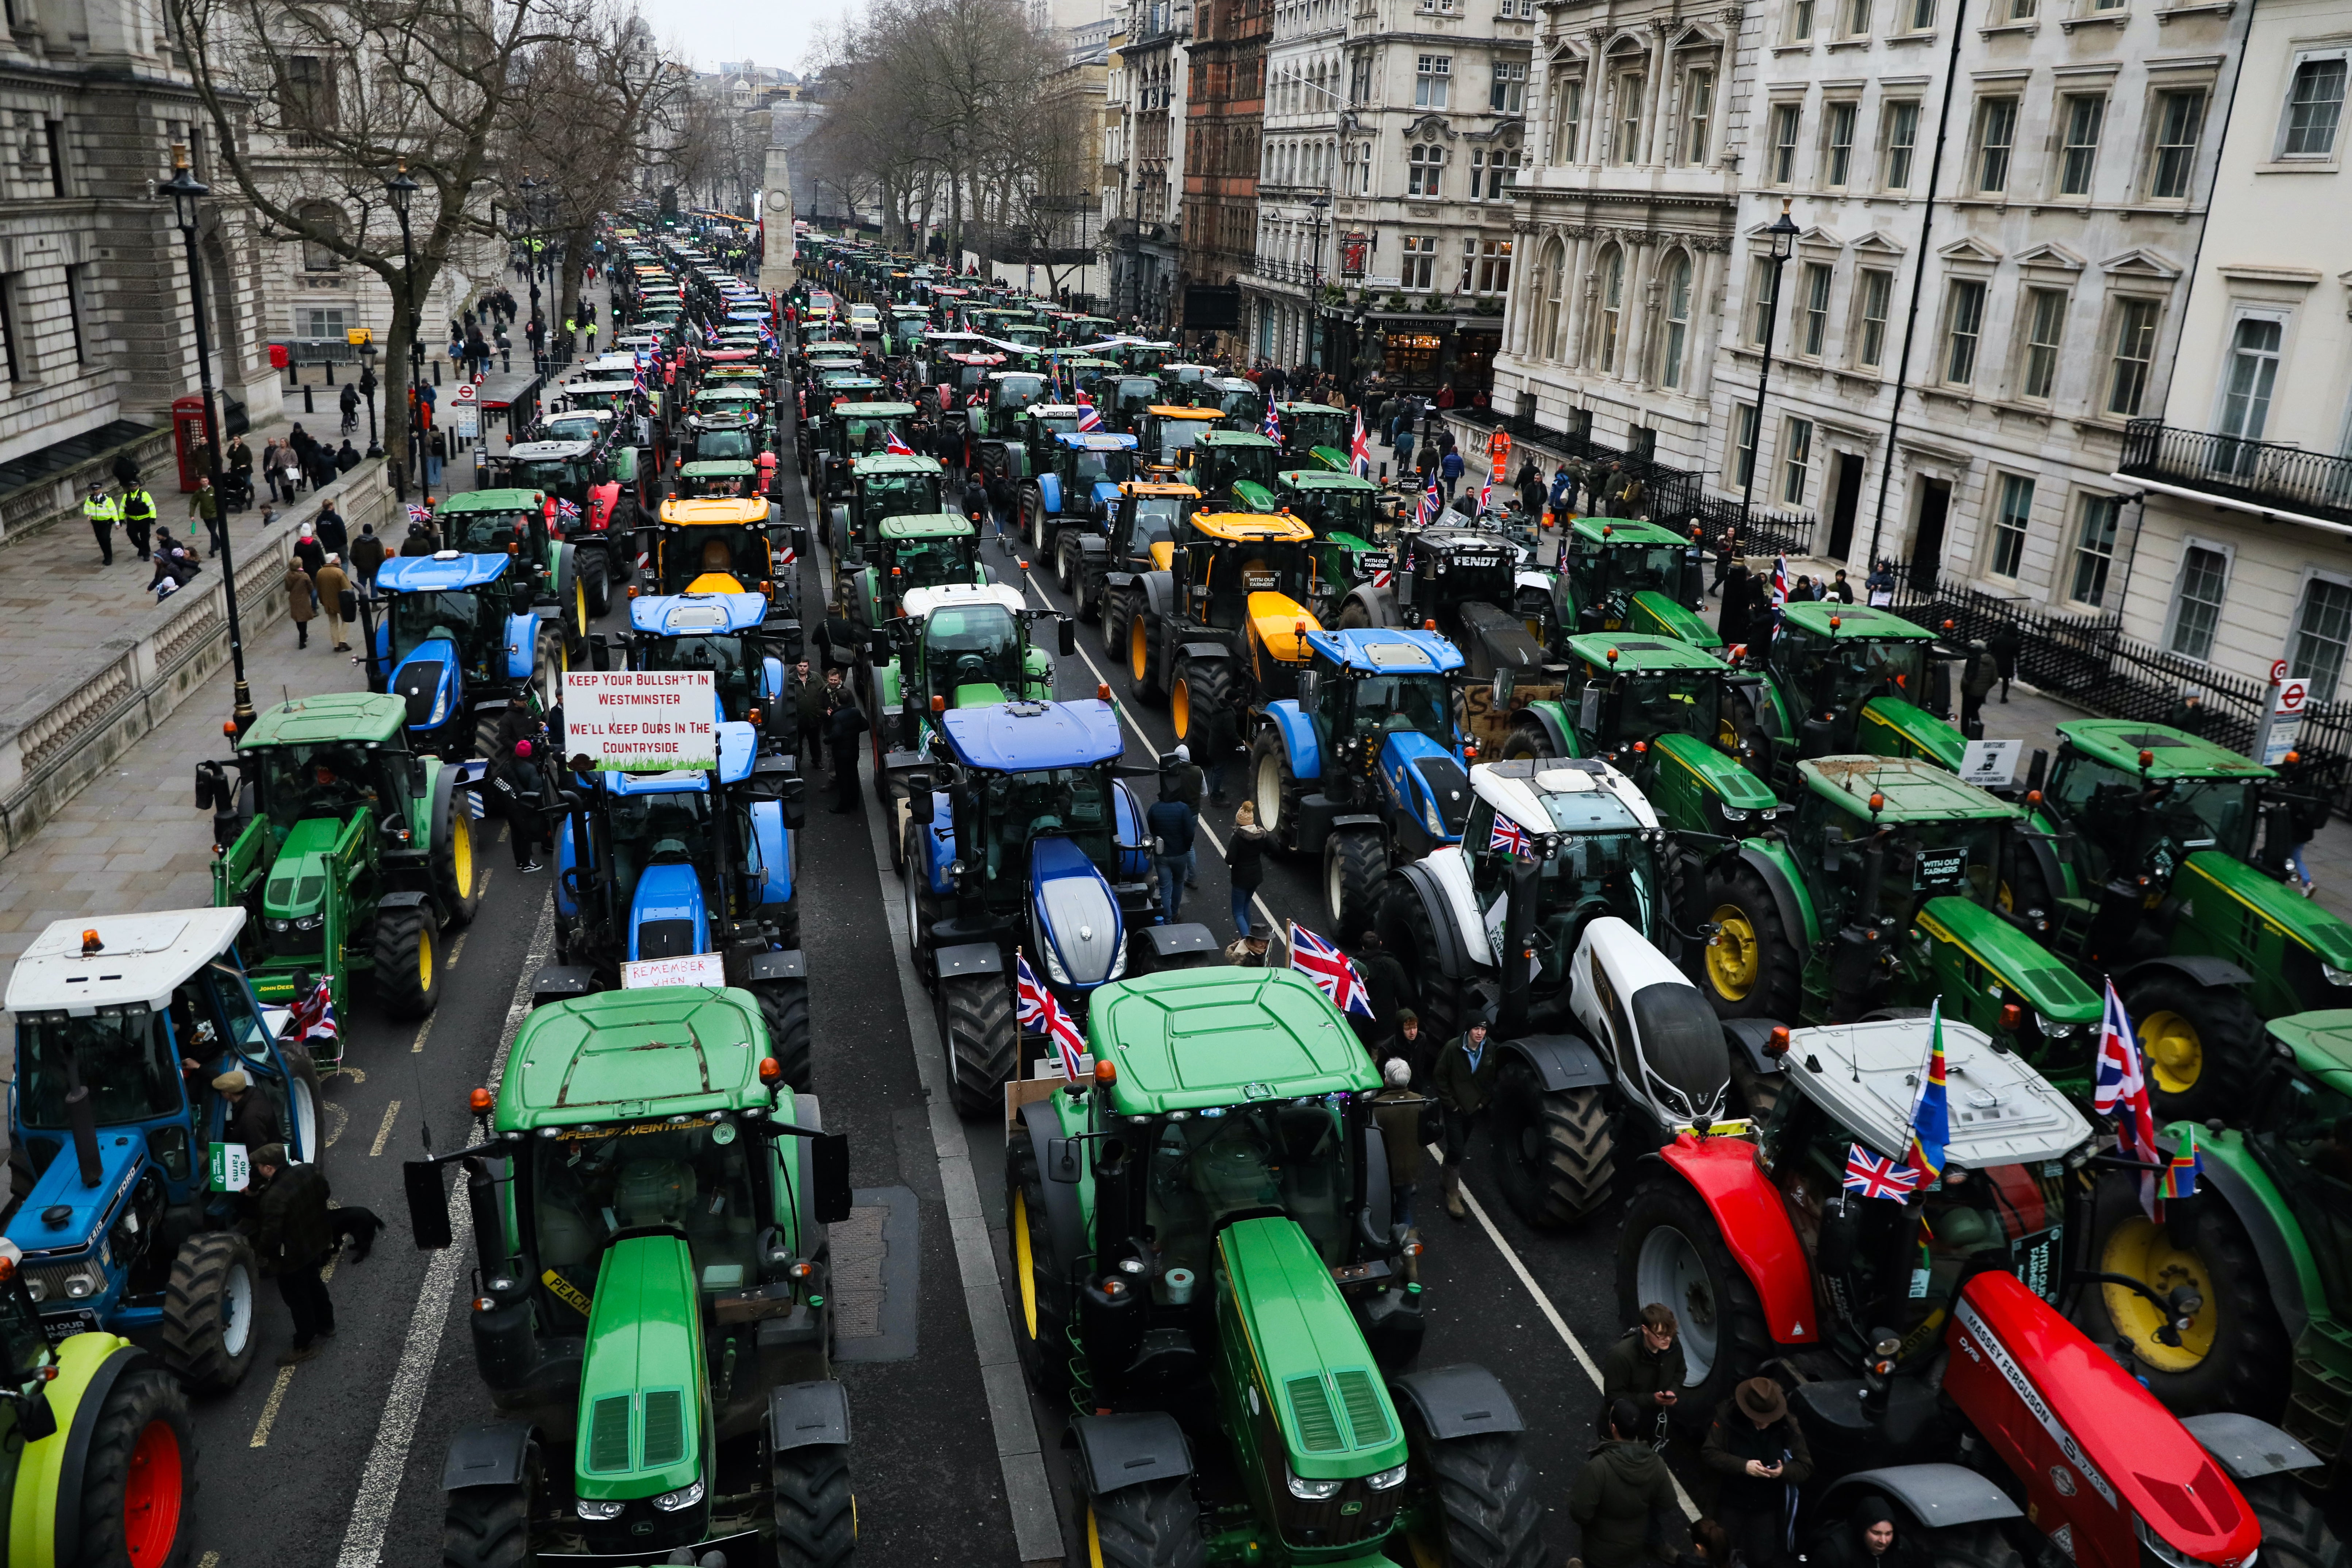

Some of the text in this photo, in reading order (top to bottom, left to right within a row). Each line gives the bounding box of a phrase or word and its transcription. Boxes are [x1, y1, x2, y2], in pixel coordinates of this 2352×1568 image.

[1453, 556, 1500, 566] FENDT
[2274, 663, 2286, 679] G
[569, 675, 598, 686] KEEP
[603, 674, 632, 686] YOUR
[698, 674, 708, 685] IN
[598, 693, 680, 705] WESTMINSTER
[570, 722, 710, 735] WE'LL KEEP OURS IN THE
[603, 742, 679, 753] COUNTRYSIDE
[1923, 860, 1944, 868] WITH
[1924, 866, 1958, 875] FARMERS
[633, 960, 705, 979] REMEMBER
[652, 977, 685, 987] WHEN
[118, 1167, 136, 1197] FORD
[88, 1221, 103, 1245] 6410
[2029, 1247, 2039, 1294] FARMER
[2038, 1241, 2049, 1298] WITH OUR
[57, 1321, 85, 1329] OUR
[48, 1329, 86, 1338] MERS
[1967, 1315, 2003, 1360] MASSEY
[2001, 1359, 2050, 1424] FERGUSON
[2063, 1436, 2077, 1461] S
